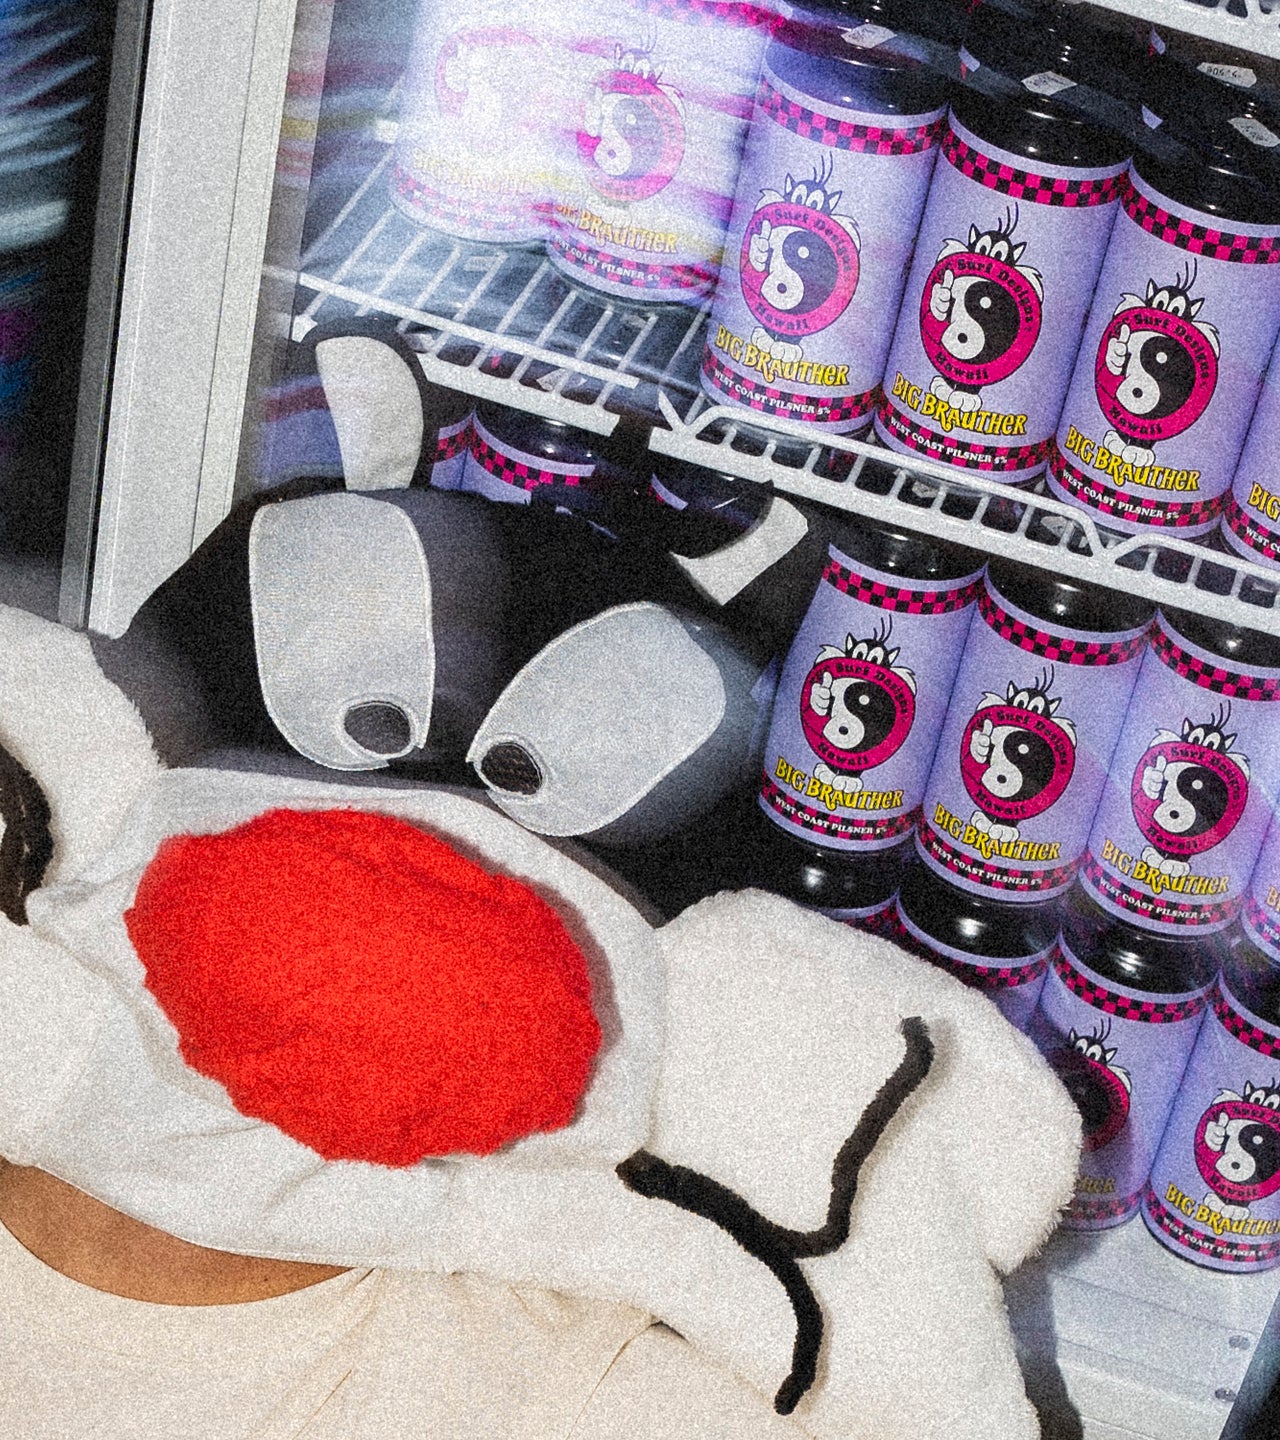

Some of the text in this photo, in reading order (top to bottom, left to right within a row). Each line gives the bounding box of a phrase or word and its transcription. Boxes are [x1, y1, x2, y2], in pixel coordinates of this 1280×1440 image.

[1133, 311, 1170, 329] Surf
[713, 324, 851, 387] BIG BRAUTHER
[934, 349, 990, 381] Hawaii
[891, 371, 1029, 437] BIG BRAUTHER
[1108, 404, 1164, 435] Hawaii
[889, 415, 912, 438] WEST
[911, 431, 945, 454] COAST
[945, 443, 993, 465] PILSNER
[1063, 422, 1202, 493] BIG BRAUTHER
[1061, 468, 1084, 491] WEST
[1083, 484, 1117, 507] COAST
[1116, 498, 1164, 519] PILSNER
[1244, 526, 1269, 549] WEST
[775, 754, 904, 812] BIG BRAUTHER
[796, 809, 830, 829] COAST
[933, 800, 1061, 862] BIG BRAUTHER
[952, 856, 985, 877] COAST
[1101, 835, 1230, 896] BIG BRAUTHER
[1164, 1181, 1196, 1217] BIG
